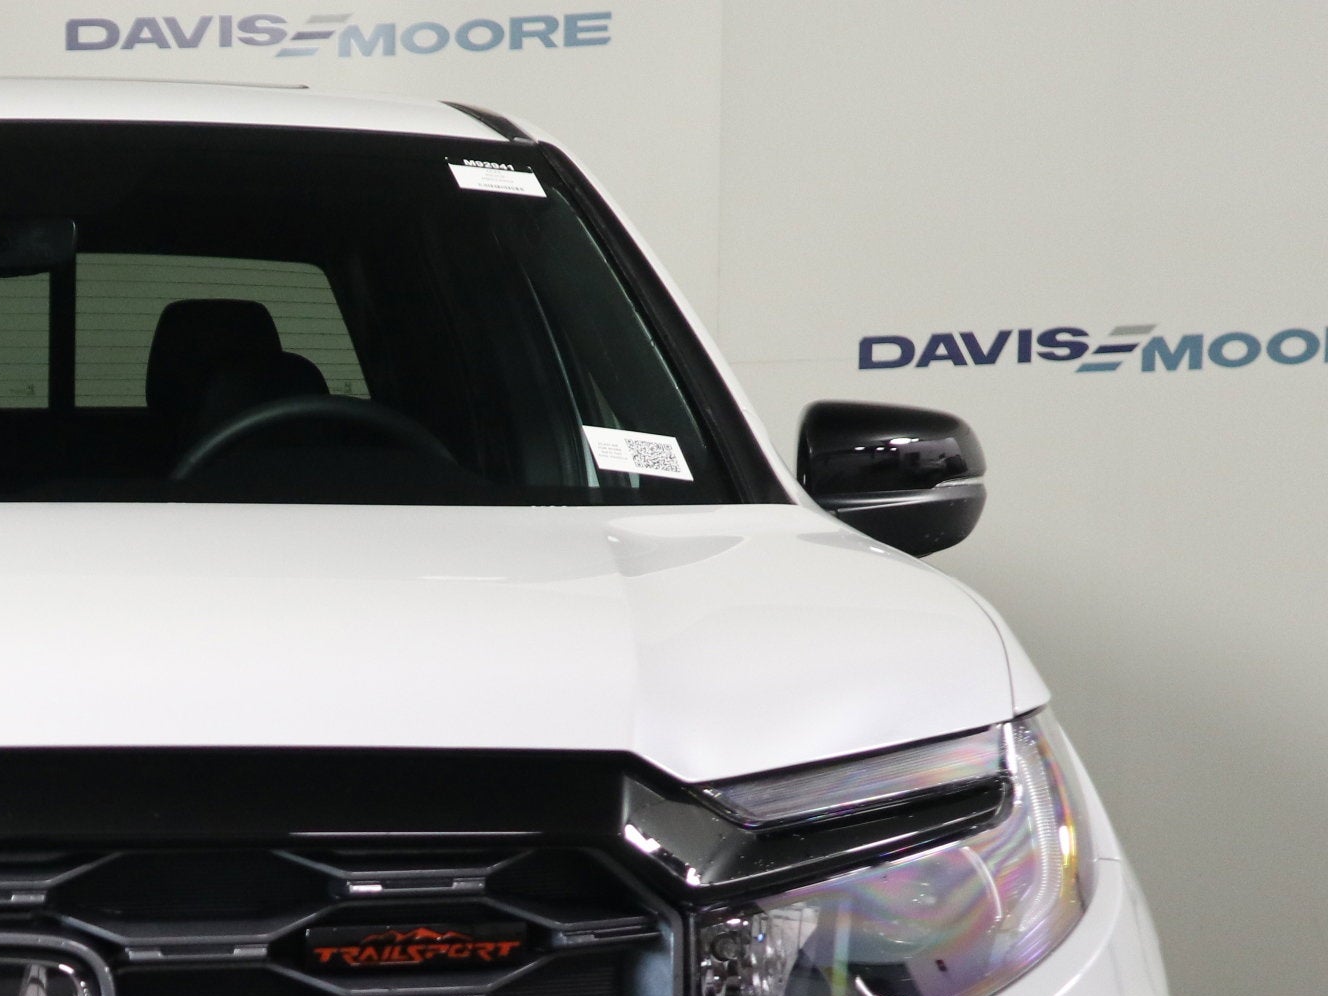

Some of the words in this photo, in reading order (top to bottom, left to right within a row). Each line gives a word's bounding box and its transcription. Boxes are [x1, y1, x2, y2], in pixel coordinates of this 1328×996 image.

[65, 14, 289, 51] DAVIS
[337, 11, 613, 58] MOORE
[858, 326, 1090, 370] DAVIS
[1141, 326, 1328, 373] MOO
[314, 941, 520, 966] TRAILSPORT
